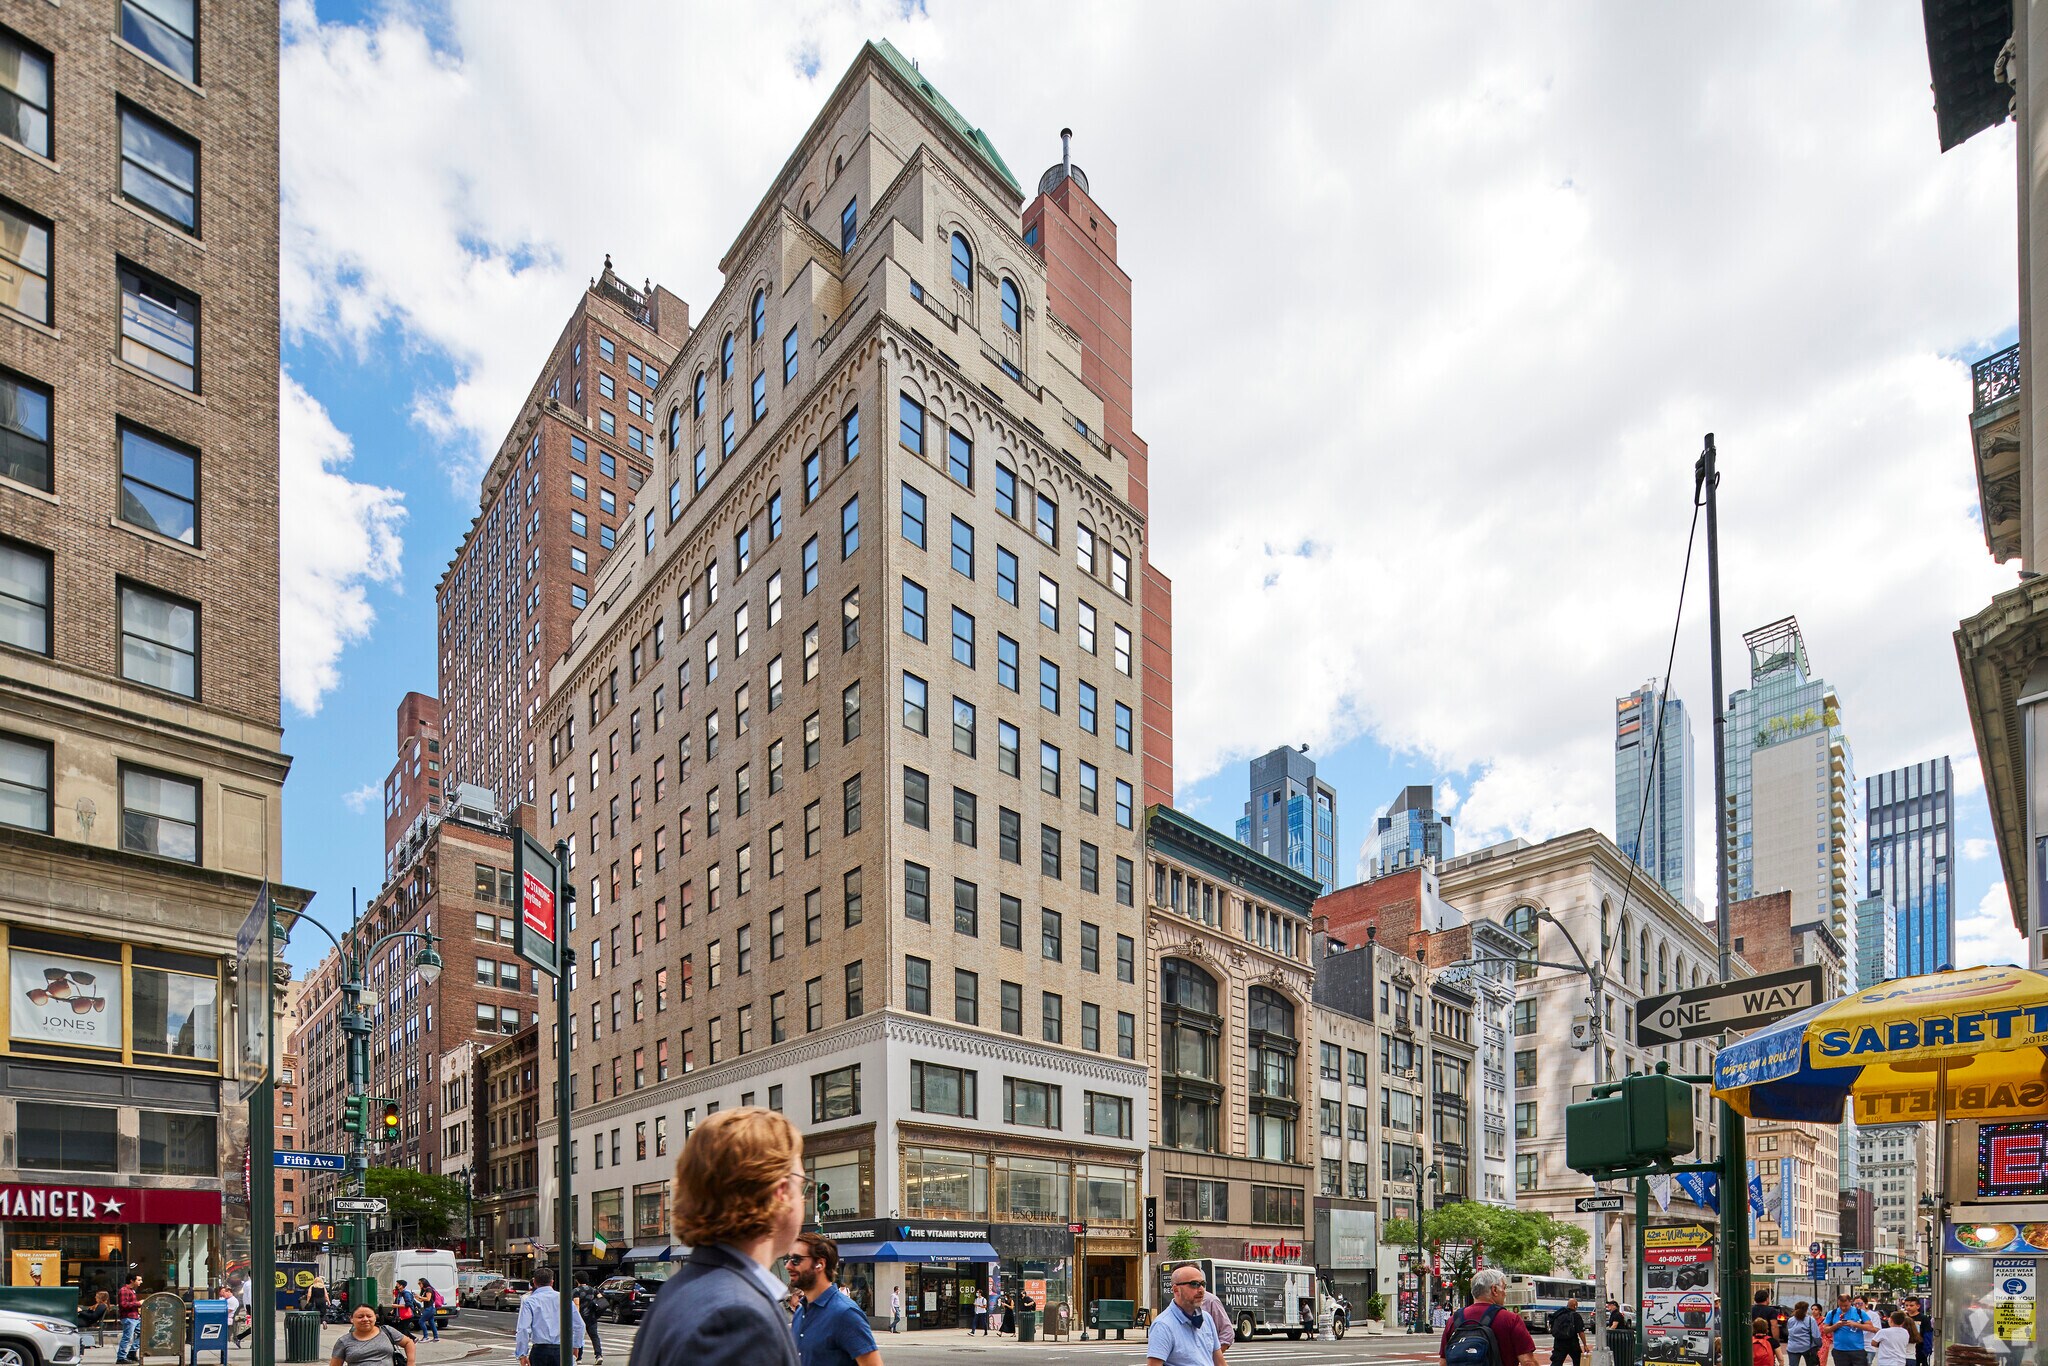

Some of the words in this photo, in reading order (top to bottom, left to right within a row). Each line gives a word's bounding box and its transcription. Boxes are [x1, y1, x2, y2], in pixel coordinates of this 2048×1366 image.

[1858, 973, 2011, 1004] SABRETT
[1659, 1002, 1711, 1029] ONE
[1743, 984, 1805, 1014] WAY
[43, 1016, 96, 1031] JONES
[1818, 1001, 2048, 1057] SABRETT
[1722, 1062, 1748, 1076] WE'RE
[1749, 1059, 1761, 1070] ON
[1761, 1057, 1767, 1067] A
[1767, 1052, 1788, 1065] ROLL
[283, 1155, 311, 1166] Fifth
[313, 1157, 334, 1167] Ave
[1991, 1134, 2048, 1186] E
[1582, 1201, 1596, 1209] ONE
[1602, 1200, 1617, 1208] WAY
[824, 1207, 855, 1220] SQUIRE
[1012, 1207, 1057, 1222] ESQUIRE
[327, 1225, 334, 1239] 0
[911, 1229, 926, 1238] THE
[926, 1229, 959, 1238] VITAMIN
[959, 1231, 987, 1239] SHOPPE
[1666, 1228, 1708, 1241] Willoughby's
[1251, 1245, 1272, 1258] NYC
[1274, 1238, 1301, 1258] GIFTS
[1749, 1255, 1775, 1265] ASE
[1225, 1271, 1266, 1287] RECOVER
[960, 1286, 976, 1294] CBD
[1225, 1294, 1259, 1307] MINUTE
